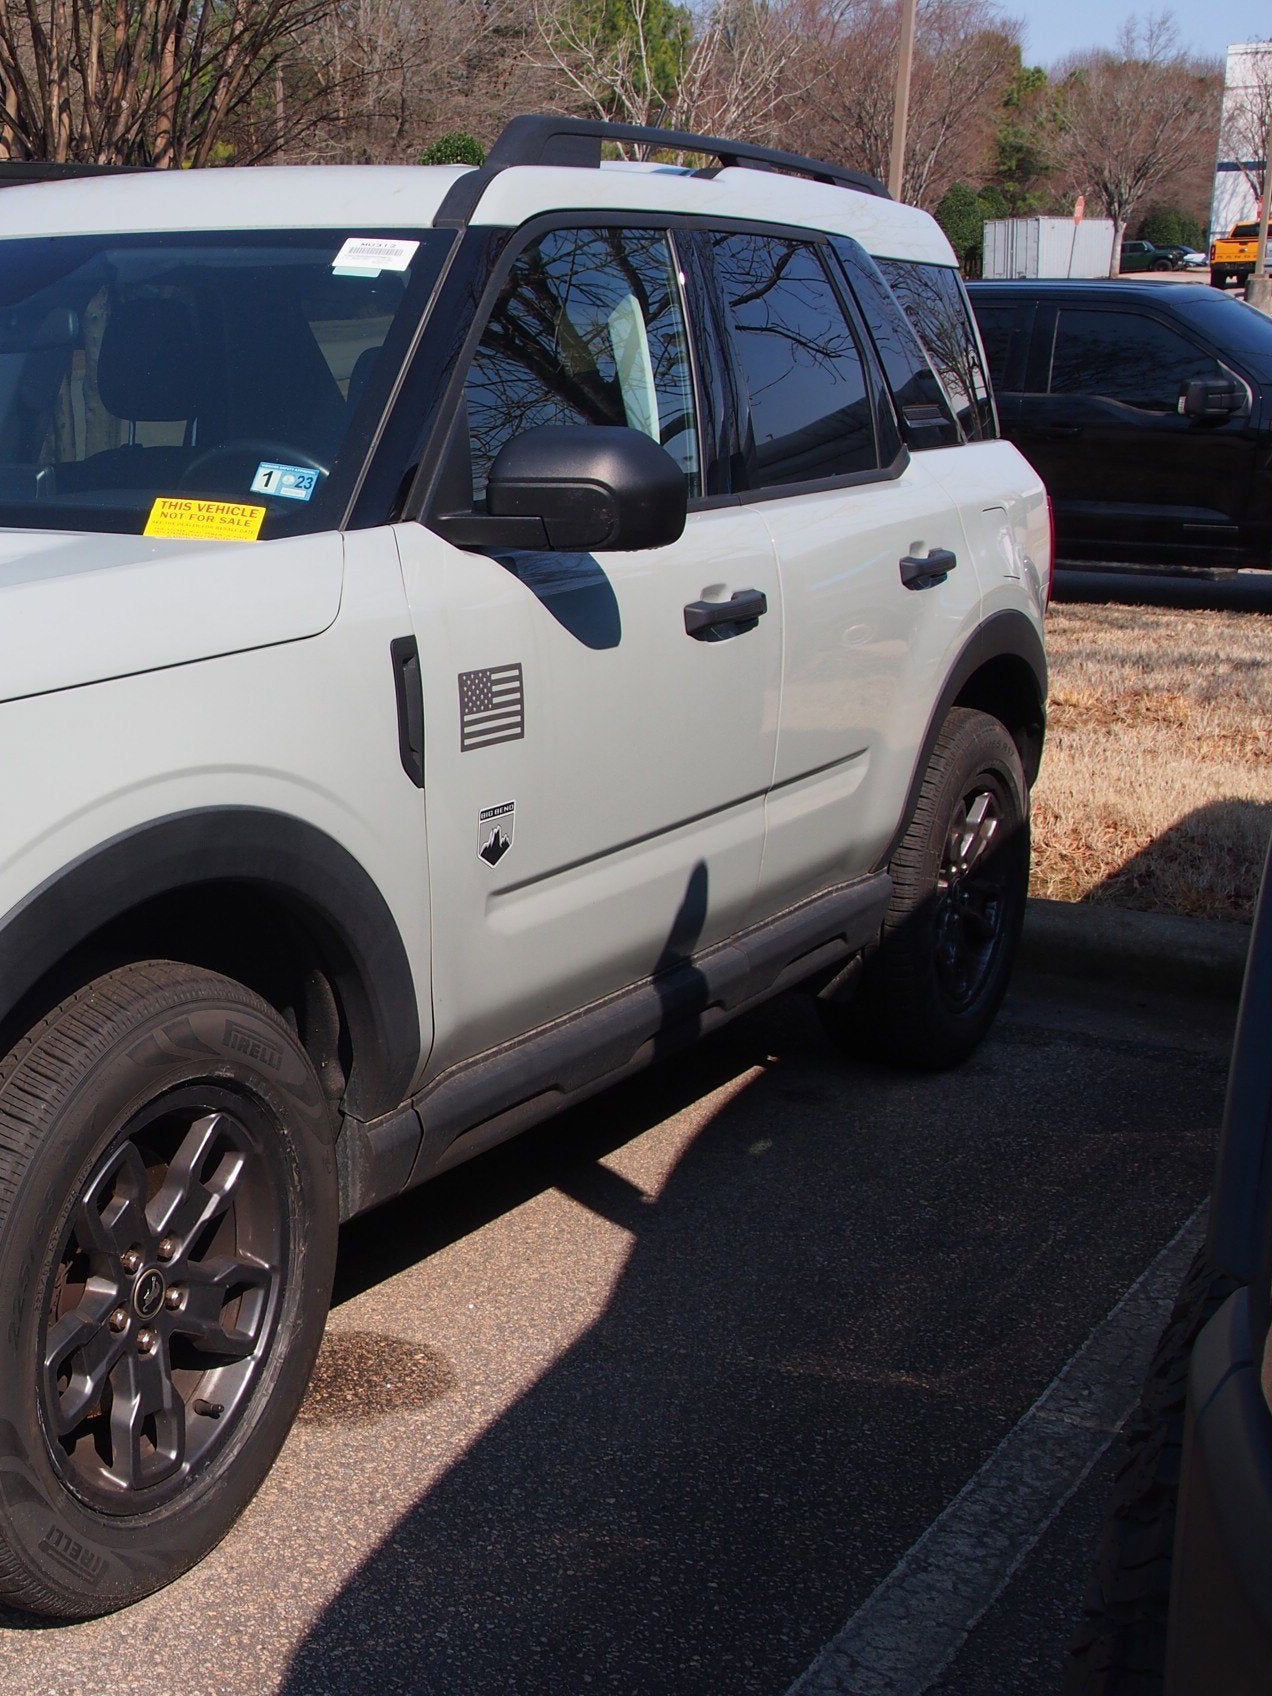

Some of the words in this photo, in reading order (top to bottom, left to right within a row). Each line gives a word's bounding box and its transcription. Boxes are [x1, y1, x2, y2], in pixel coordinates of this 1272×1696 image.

[262, 470, 274, 487] 1
[294, 475, 314, 490] 23
[159, 511, 184, 520] NOT
[188, 513, 215, 523] FOR
[219, 516, 253, 527] SALE
[160, 500, 193, 511] THIS
[197, 503, 259, 519] VEHICLE
[480, 810, 494, 820] BIG
[494, 804, 514, 816] BEND
[223, 1019, 284, 1072] PIRELLI
[37, 1525, 109, 1587] PIRELLI
